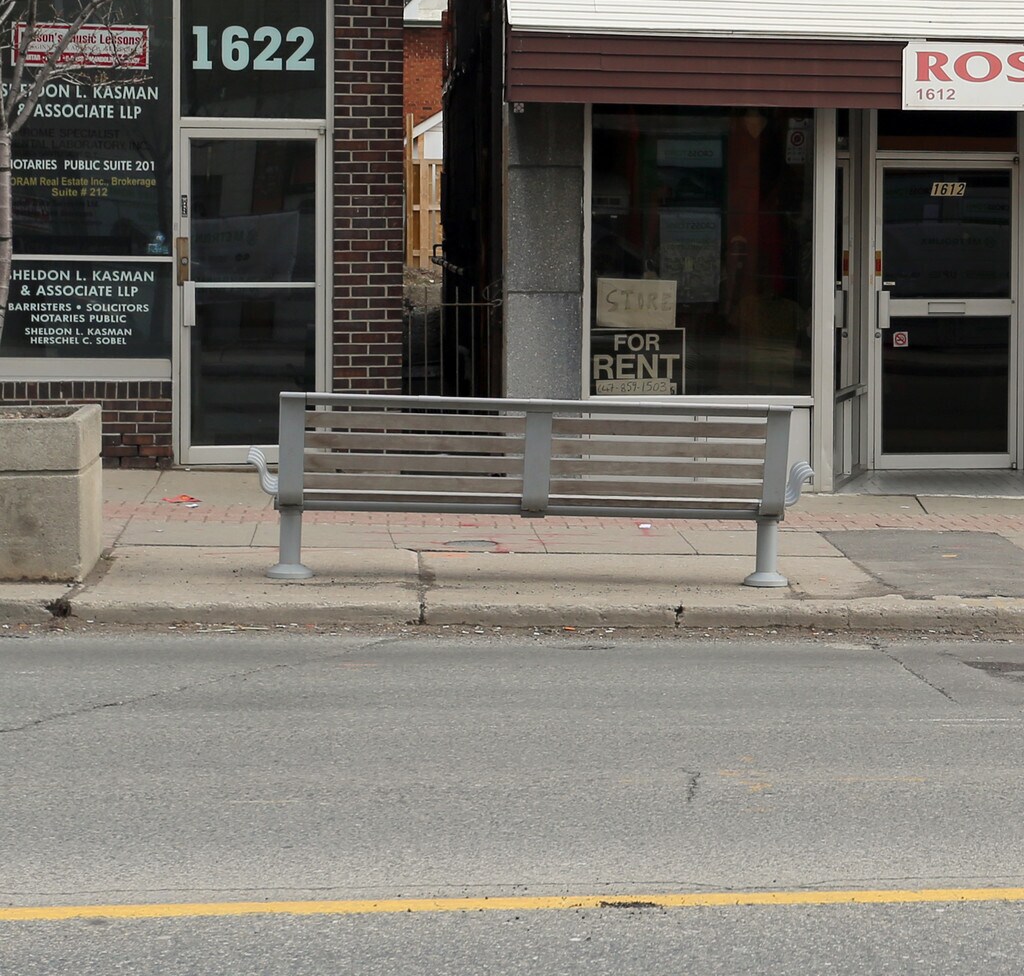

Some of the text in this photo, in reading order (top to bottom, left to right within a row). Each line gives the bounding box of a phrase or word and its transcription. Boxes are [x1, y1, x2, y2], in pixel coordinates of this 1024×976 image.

[99, 34, 141, 45] Lessons
[192, 25, 315, 71] 1622
[76, 85, 86, 99] L.
[93, 85, 158, 100] KASMAN
[916, 88, 956, 100] 1612
[33, 103, 114, 119] ASSOCIATE
[120, 105, 142, 119] LLP
[64, 159, 101, 171] PUBLIC
[103, 160, 133, 171] SUITE
[135, 160, 155, 172] 201
[40, 177, 59, 186] Real
[61, 177, 89, 186] Estate
[111, 177, 157, 188] Brokerage
[51, 187, 108, 197] Suite # 212
[933, 183, 965, 195] 1612
[76, 270, 86, 281] L.
[92, 270, 154, 282] KASMAN
[20, 284, 139, 297] & ASSOCIATE LLP
[606, 289, 672, 312] STORE
[8, 303, 149, 312] BARRISTERS SOLICITORS
[31, 314, 127, 323] NOTARIES PUBLIC
[25, 327, 132, 336] SHELDON L. KASMAN
[82, 337, 92, 345] C.
[96, 337, 127, 345] SOBEL
[613, 333, 660, 352] FOR
[593, 353, 680, 380] RENT
